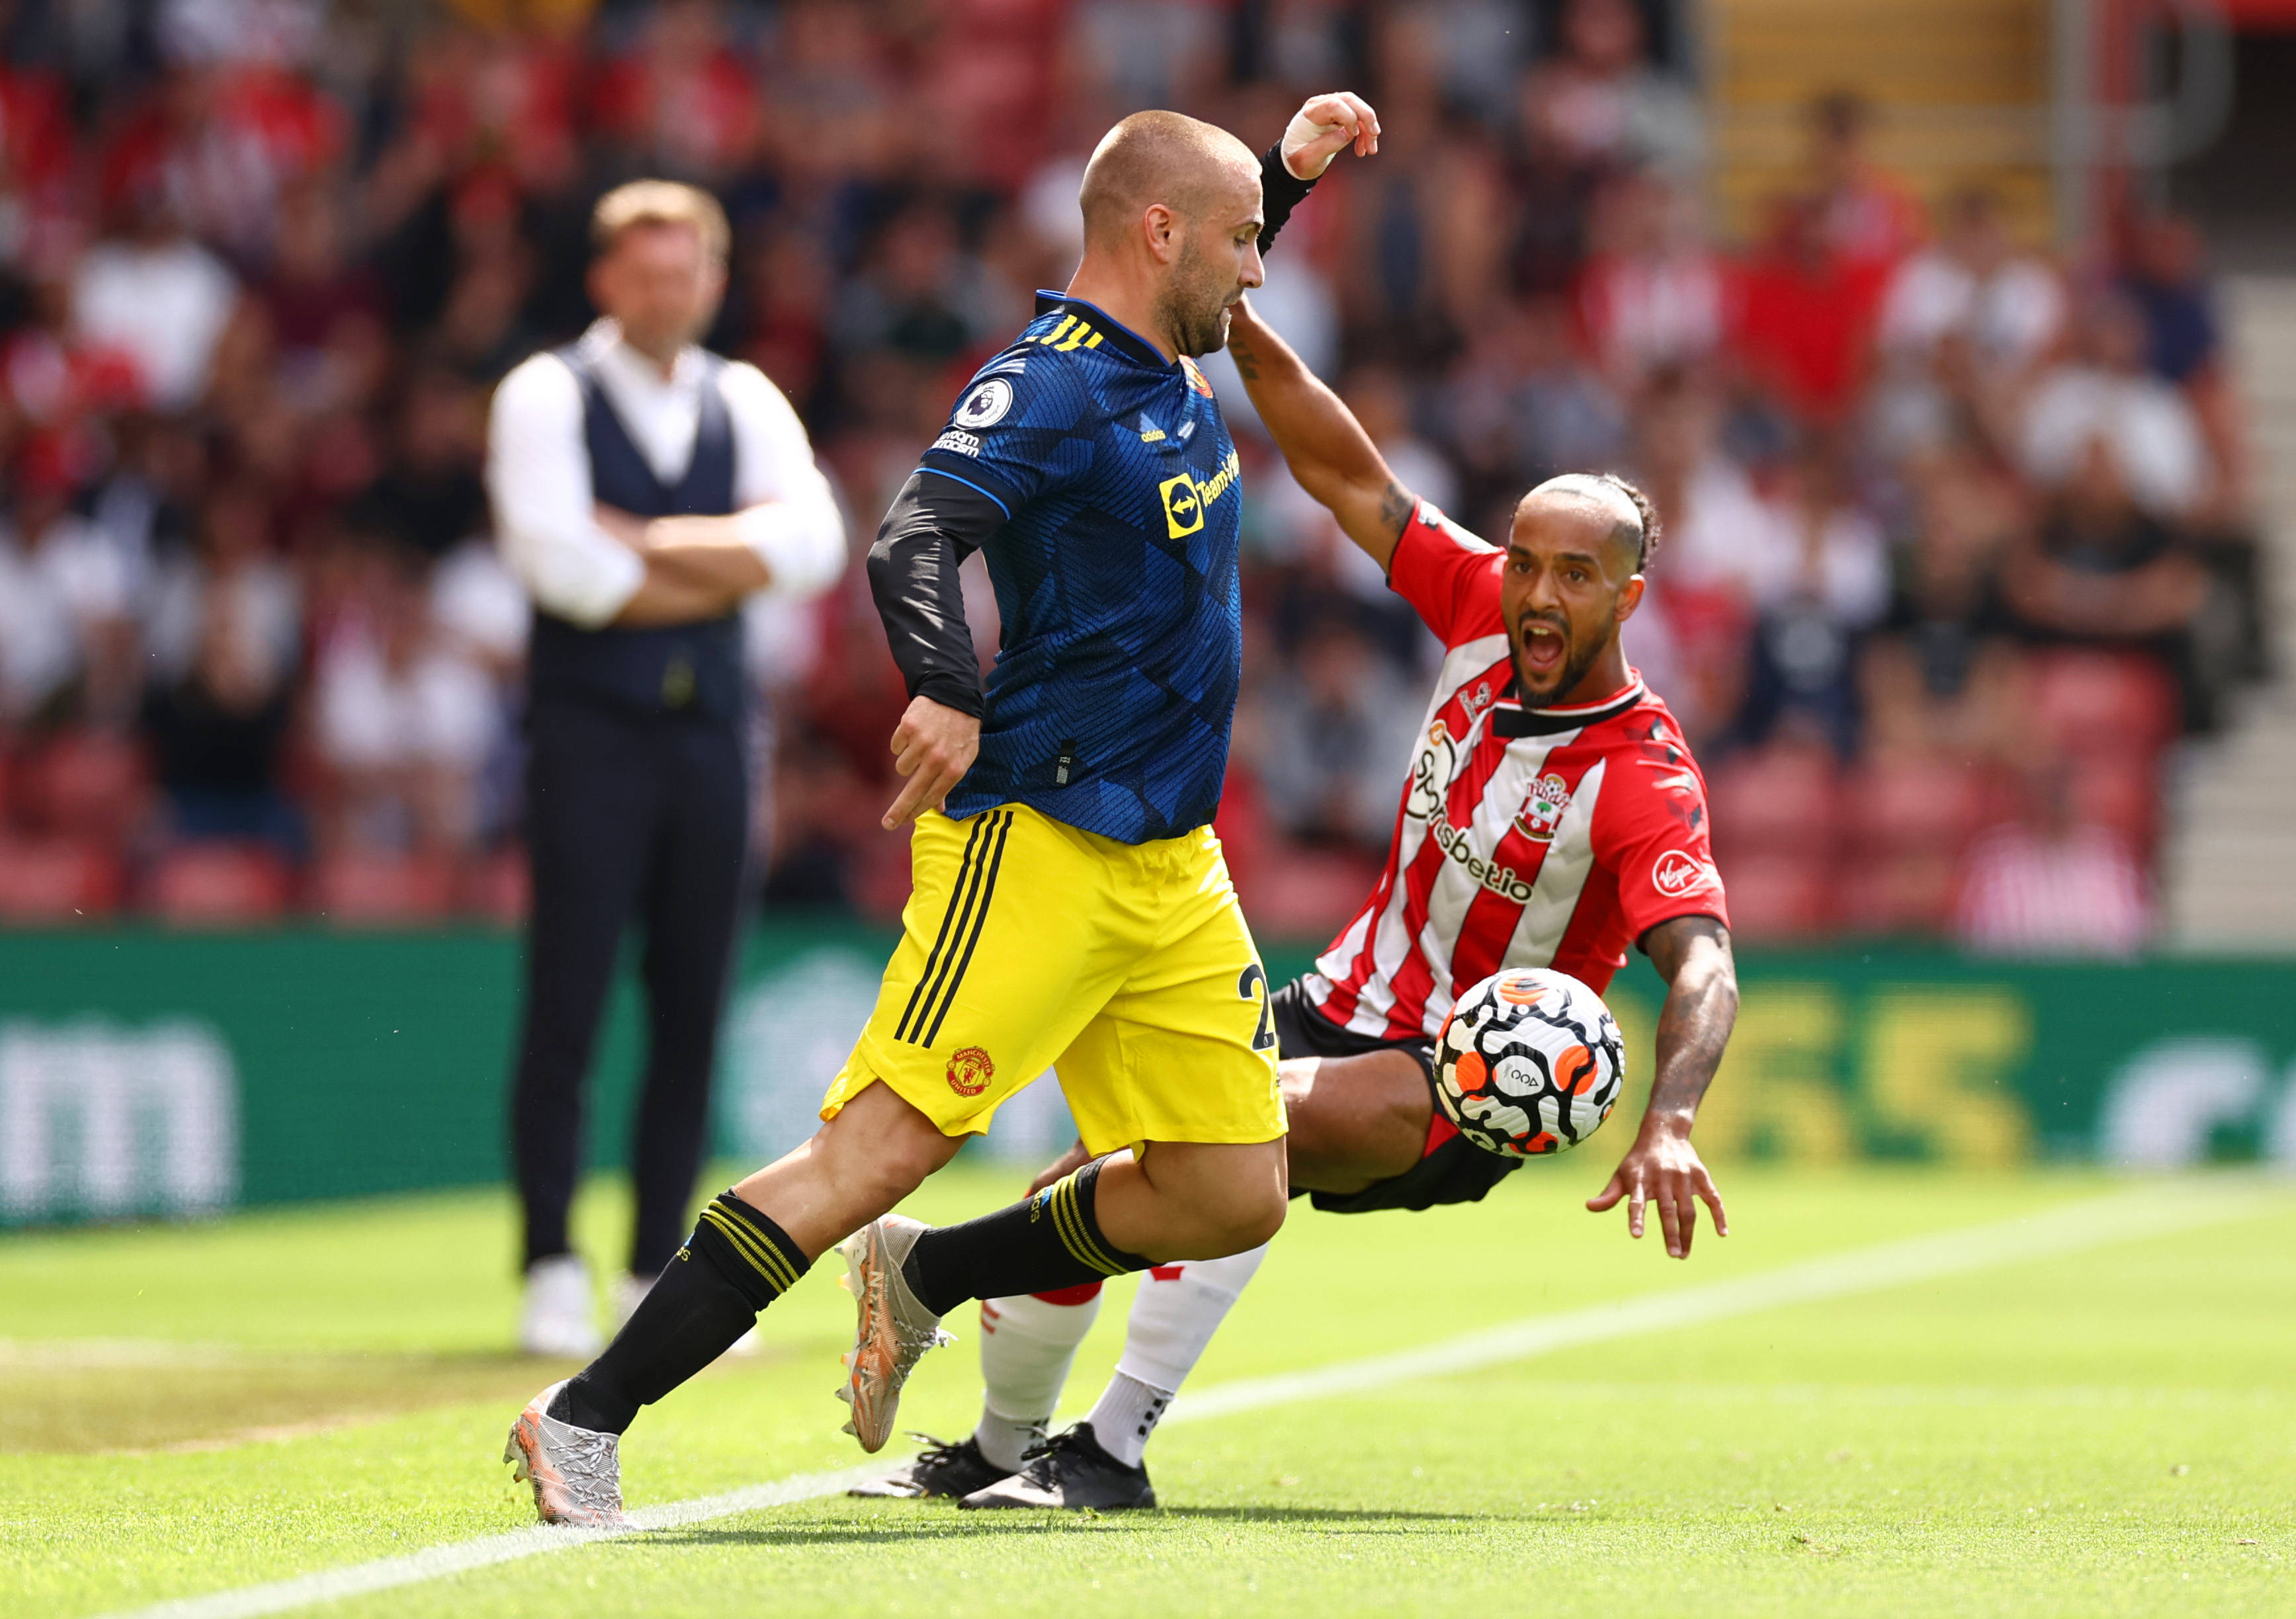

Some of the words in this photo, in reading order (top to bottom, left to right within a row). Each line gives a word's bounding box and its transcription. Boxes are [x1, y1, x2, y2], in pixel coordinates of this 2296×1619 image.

[1141, 429, 1166, 442] adidas
[1659, 858, 1695, 888] Virgin
[957, 1050, 991, 1073] MANCHESTER
[951, 1079, 976, 1095] UNITED
